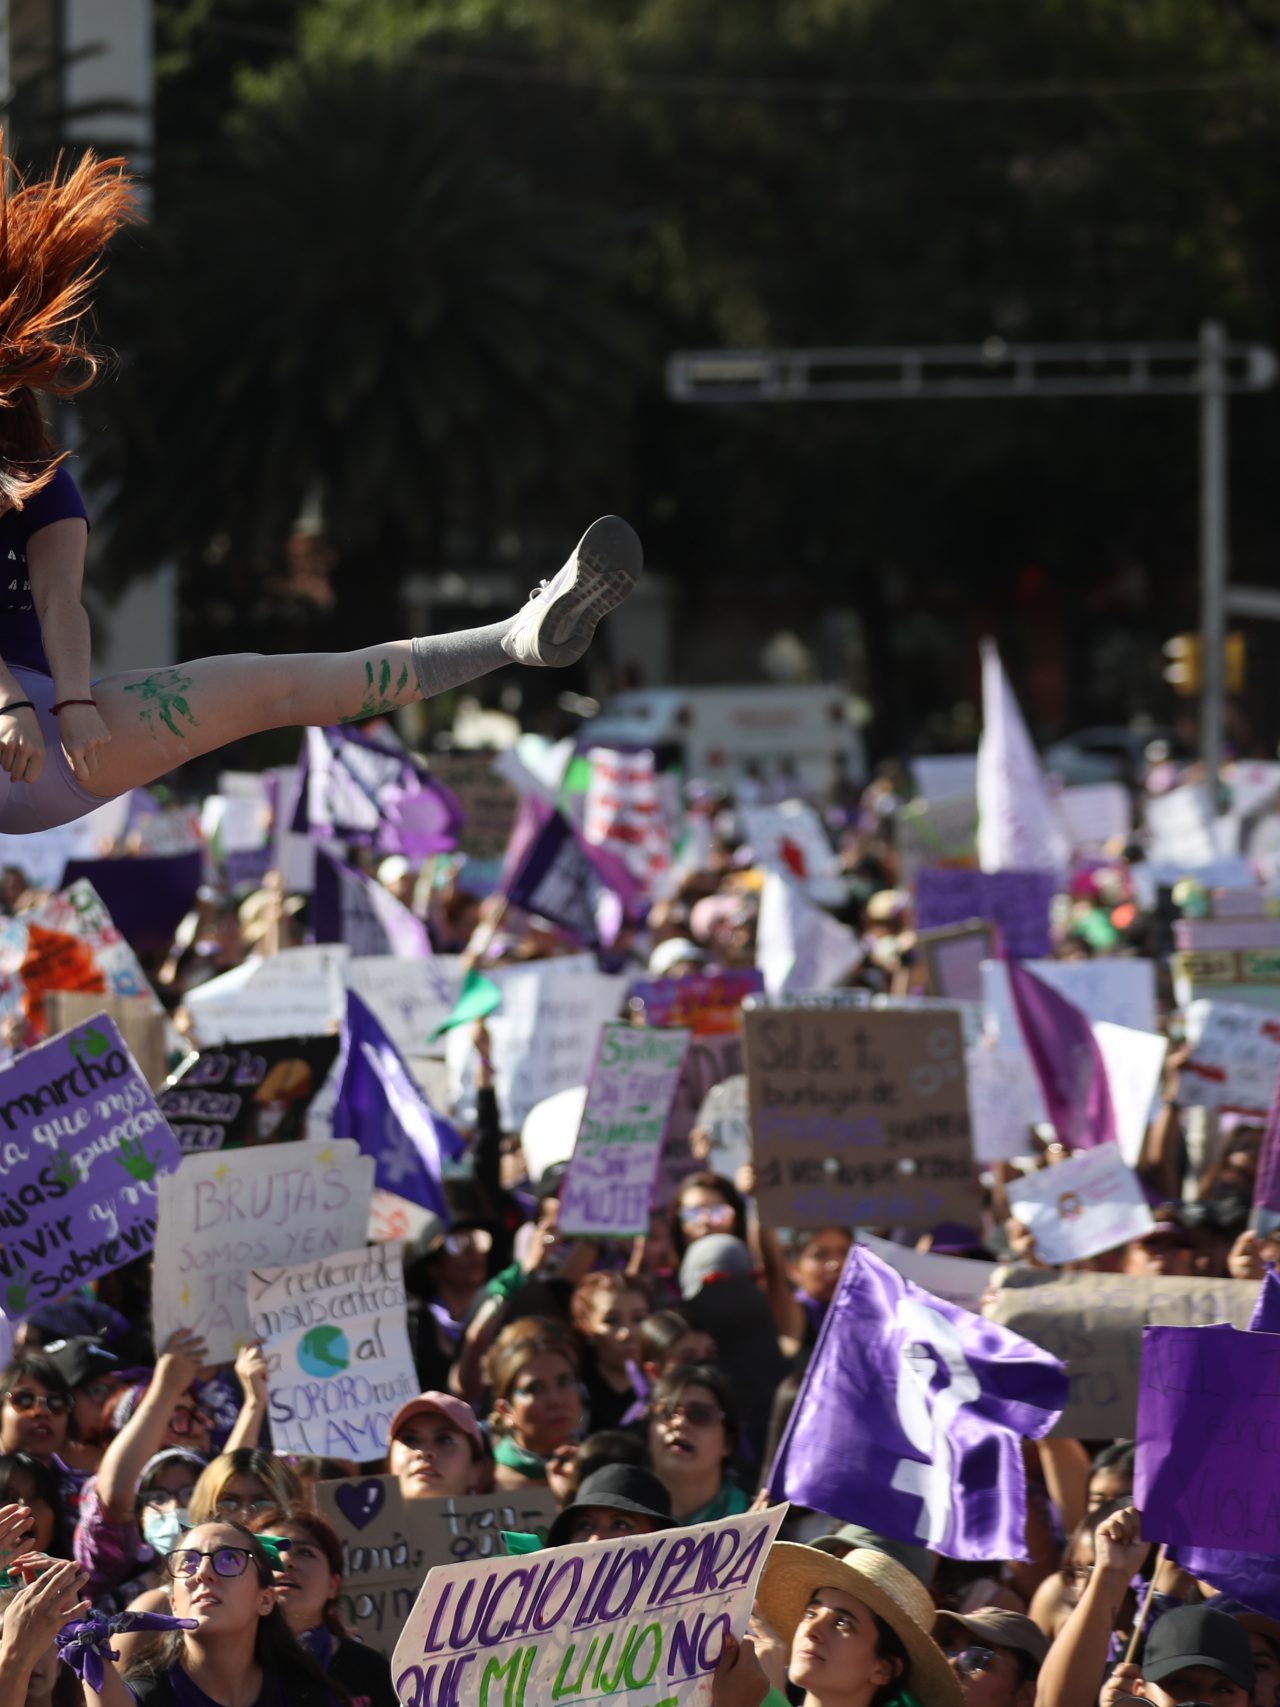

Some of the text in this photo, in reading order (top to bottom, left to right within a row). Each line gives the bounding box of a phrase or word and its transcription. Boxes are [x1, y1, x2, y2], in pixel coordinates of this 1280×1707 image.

[31, 1106, 92, 1150] que
[94, 1078, 148, 1120] mis
[88, 1199, 119, 1240] y
[193, 1166, 353, 1234] BRUJAS
[356, 1317, 386, 1361] al
[325, 1411, 395, 1457] AMO
[1176, 1463, 1280, 1539] VIOLA
[646, 1524, 771, 1607] PARA
[478, 1644, 538, 1707] MI
[551, 1620, 664, 1702] HIJO
